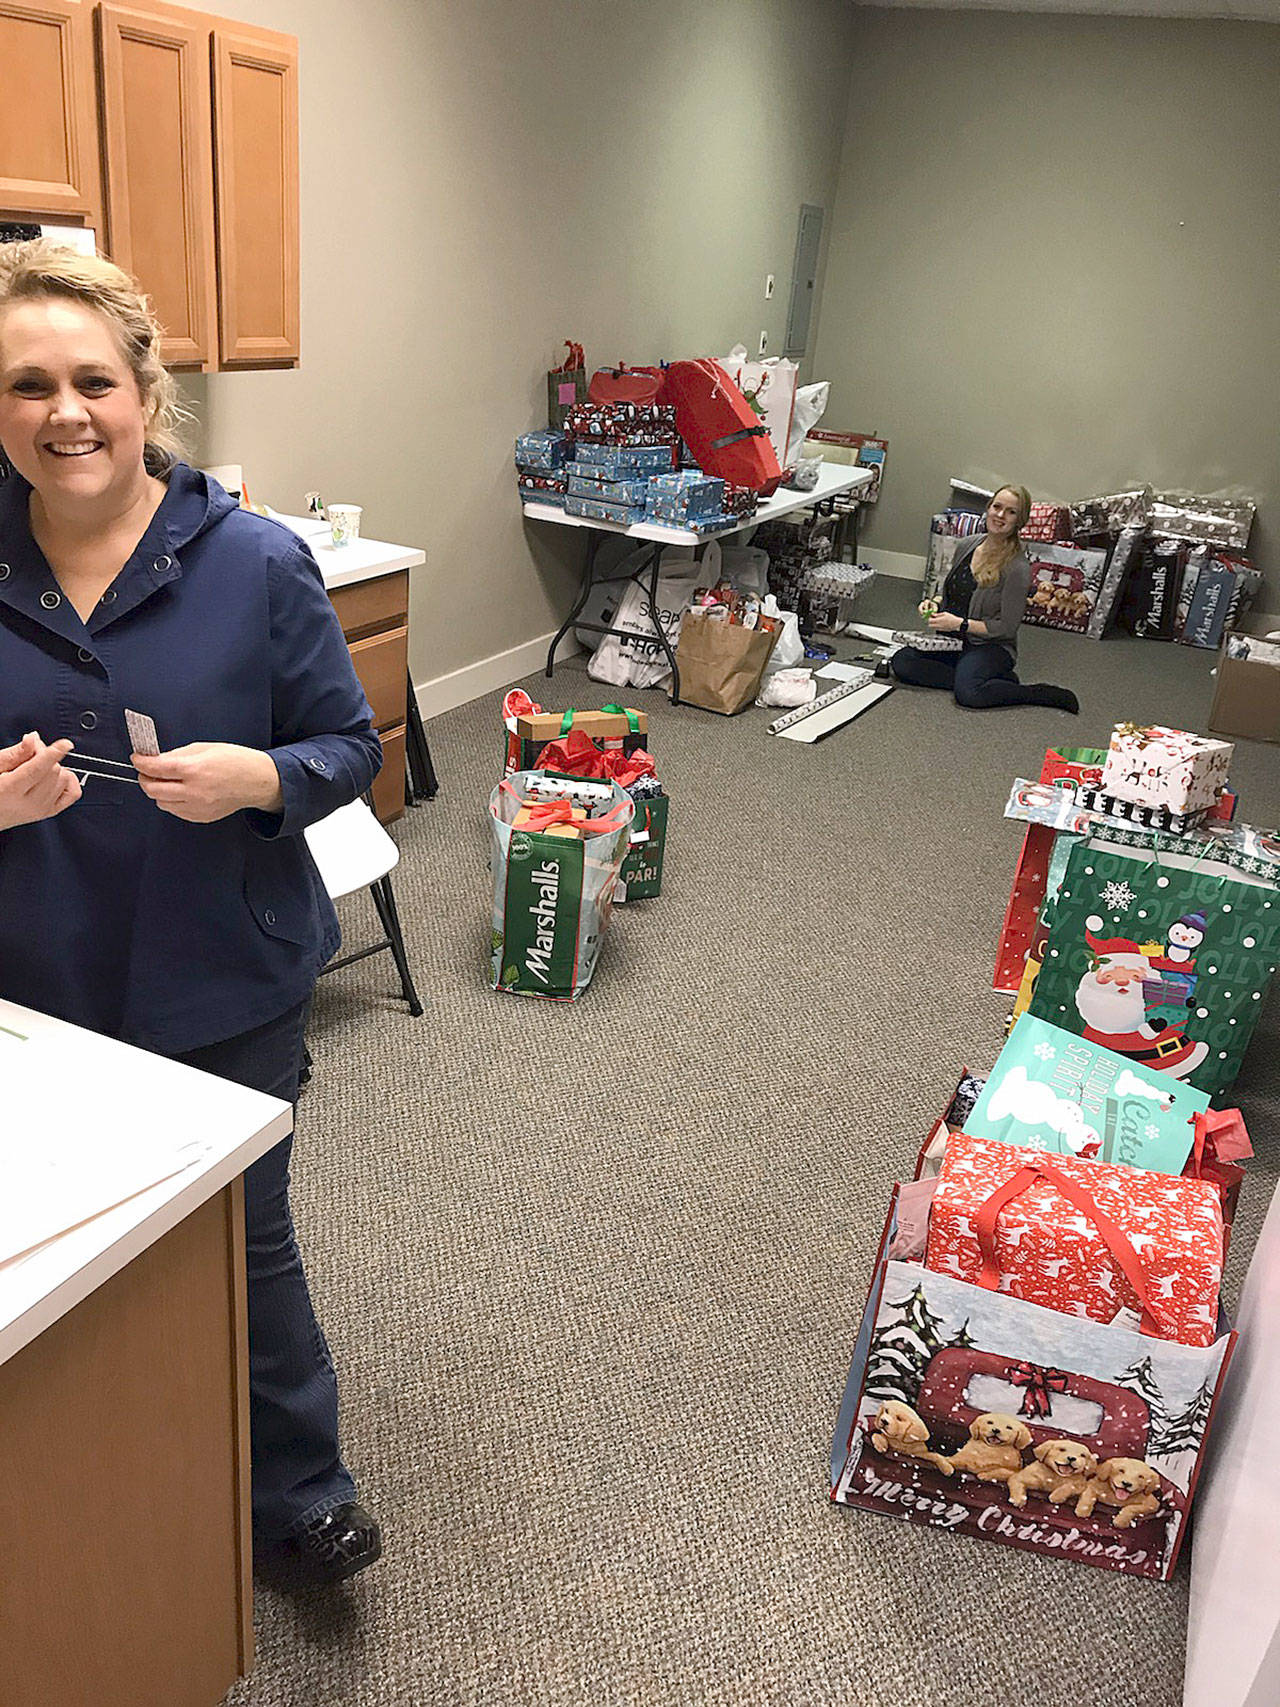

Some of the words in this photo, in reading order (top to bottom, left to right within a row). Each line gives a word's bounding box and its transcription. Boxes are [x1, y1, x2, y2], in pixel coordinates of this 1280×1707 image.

[1147, 566, 1167, 629] Marshalls
[1195, 583, 1221, 645] Marshalls
[525, 858, 560, 984] Marshalls
[1049, 1043, 1093, 1097] SPIRIT
[1081, 1055, 1120, 1114] HOLIDAY
[863, 1467, 970, 1527] Merry
[977, 1504, 1147, 1565] Christmas
